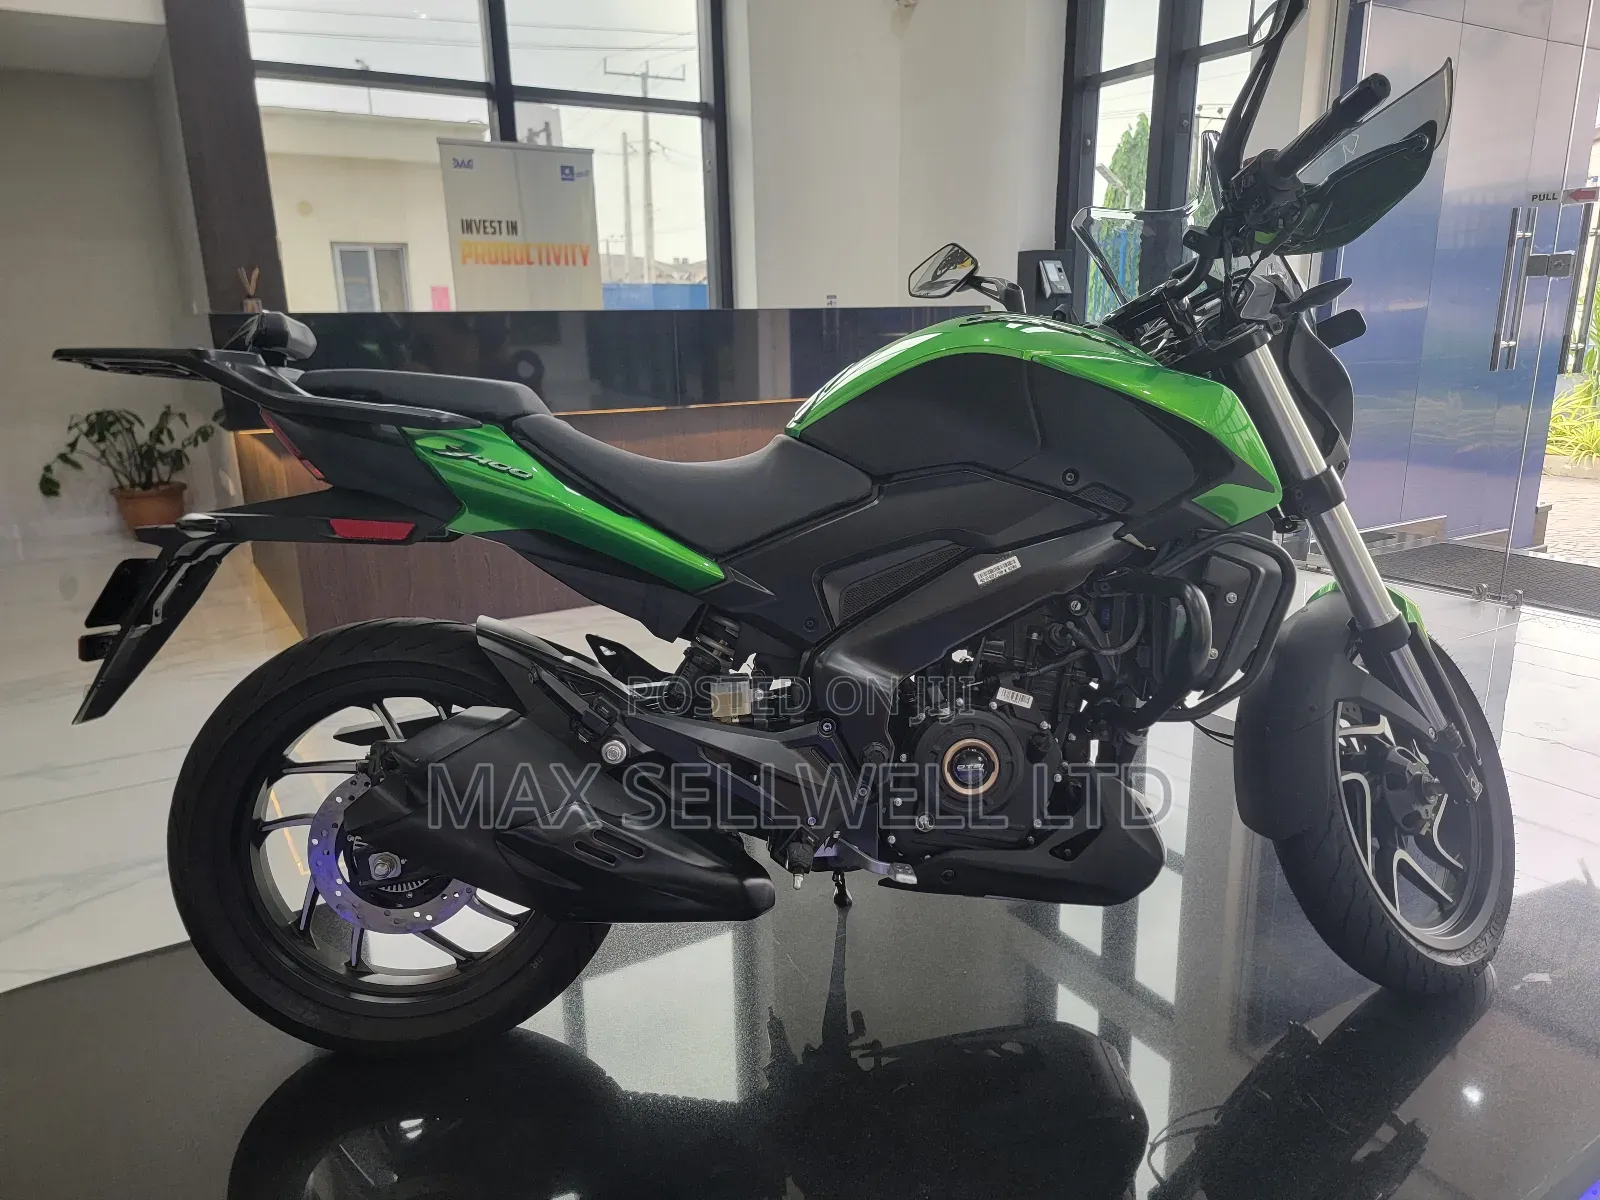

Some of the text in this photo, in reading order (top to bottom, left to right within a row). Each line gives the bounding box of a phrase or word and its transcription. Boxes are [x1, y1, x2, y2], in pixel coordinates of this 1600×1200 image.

[1531, 192, 1558, 202] PULL
[460, 218, 518, 237] INVEST IN
[461, 240, 591, 267] PRODUCTIVITY
